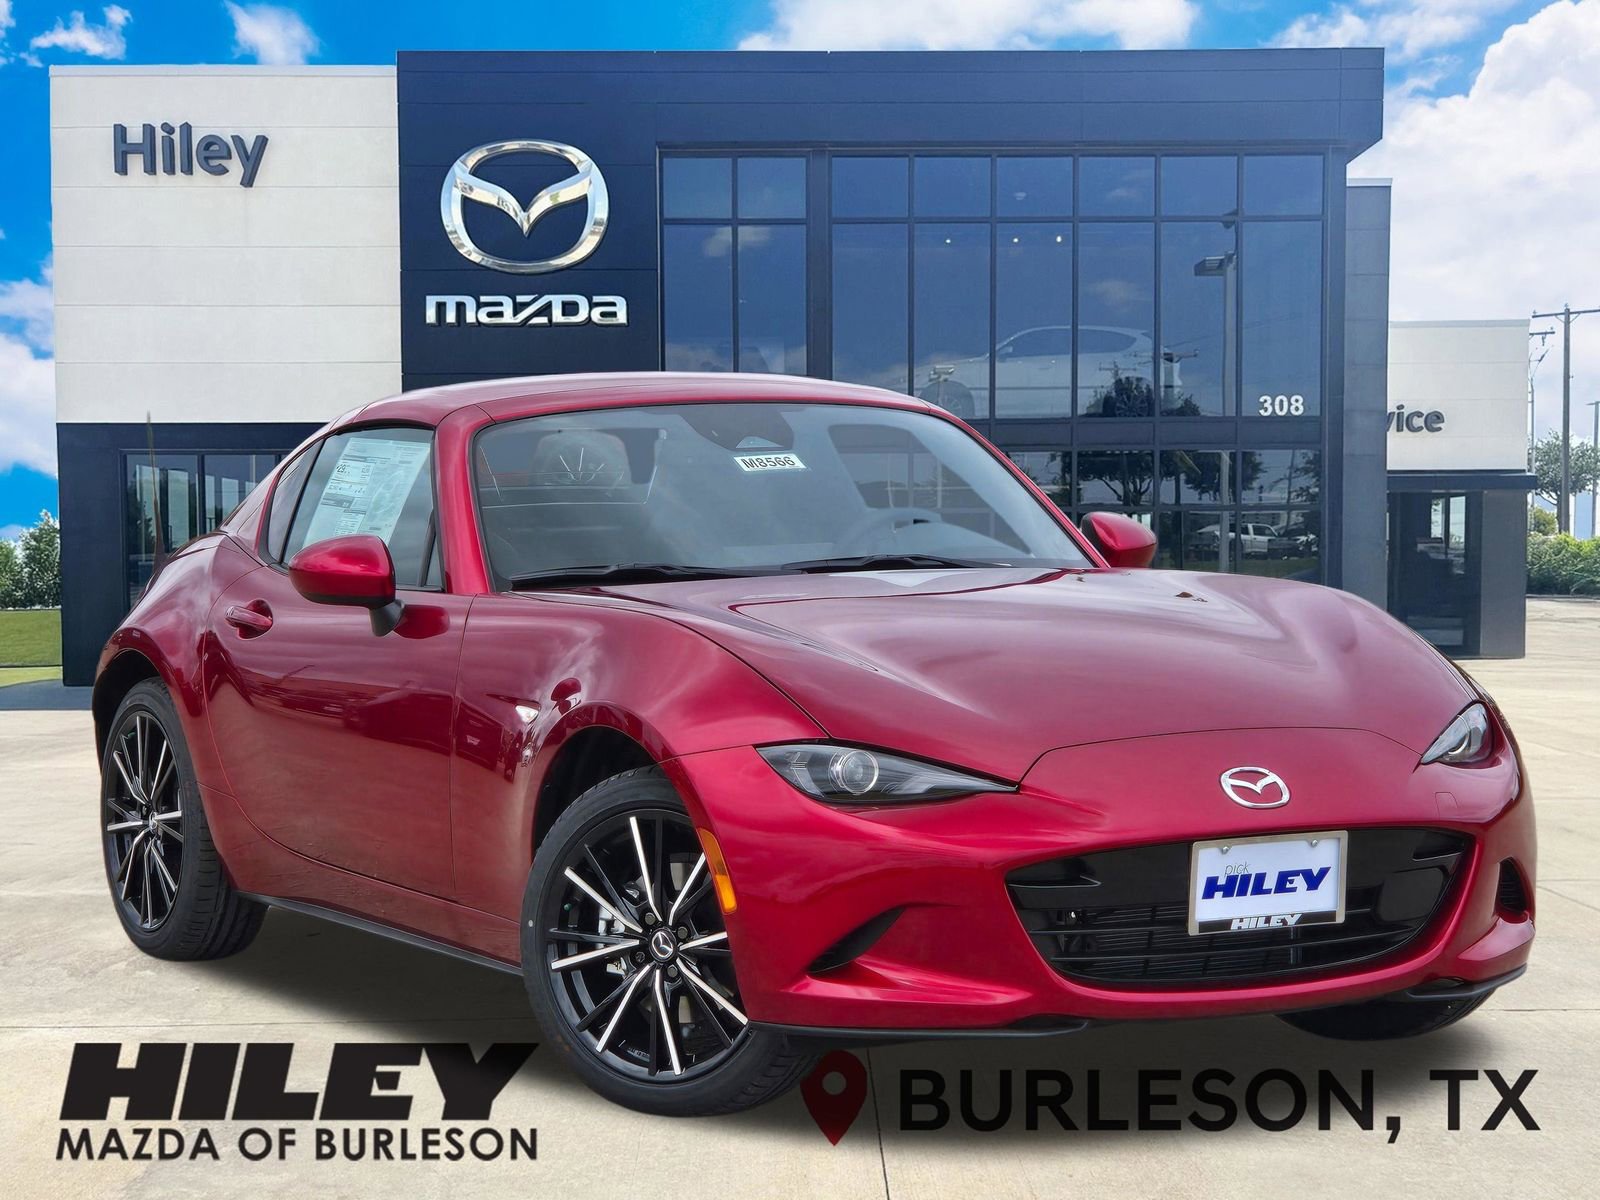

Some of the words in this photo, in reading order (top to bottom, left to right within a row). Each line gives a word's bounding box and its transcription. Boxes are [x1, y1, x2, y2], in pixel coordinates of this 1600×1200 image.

[113, 122, 268, 188] Hiley
[1258, 395, 1305, 416] 308
[740, 456, 796, 469] M8566
[1224, 861, 1251, 876] pick
[1201, 866, 1332, 900] HILEY
[1230, 913, 1303, 931] HILEY
